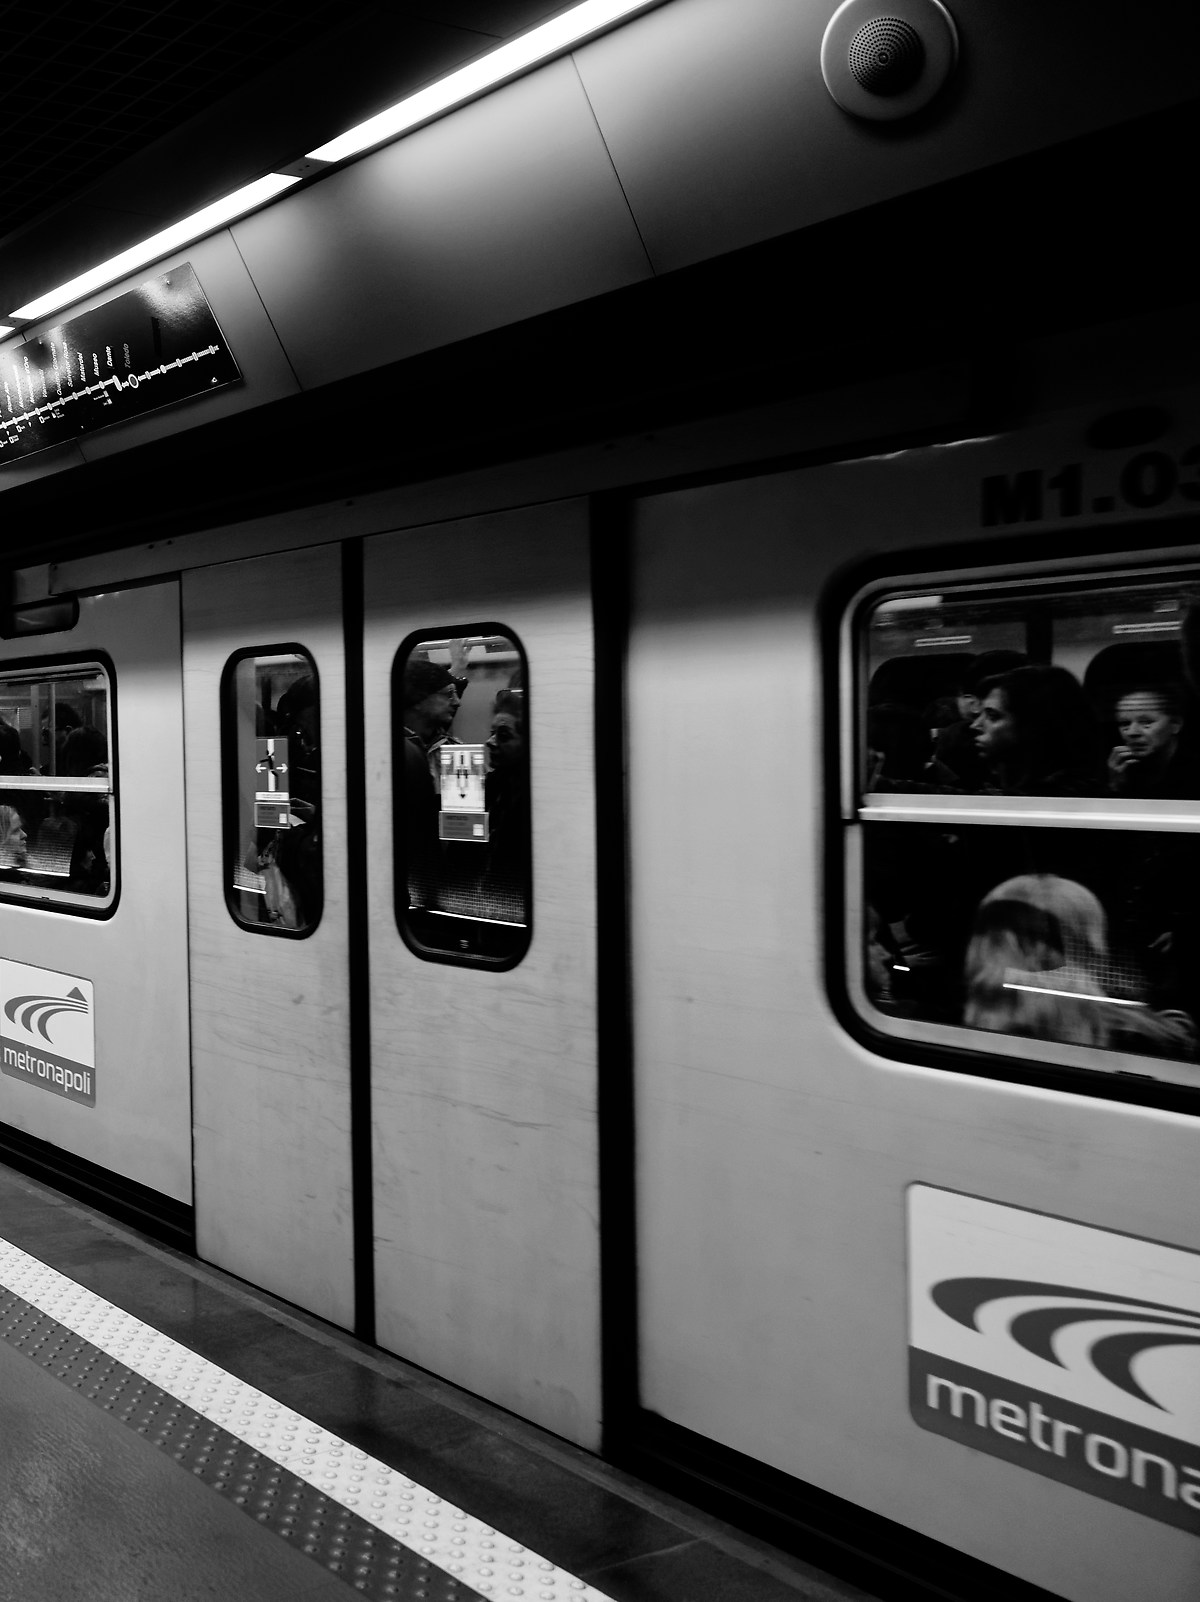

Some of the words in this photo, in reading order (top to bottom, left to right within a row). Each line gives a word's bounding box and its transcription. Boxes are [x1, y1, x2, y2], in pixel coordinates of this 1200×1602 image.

[92, 352, 100, 377] Museo
[105, 345, 113, 367] Dante
[123, 343, 131, 369] Toledo
[3, 1046, 91, 1095] metronapoli
